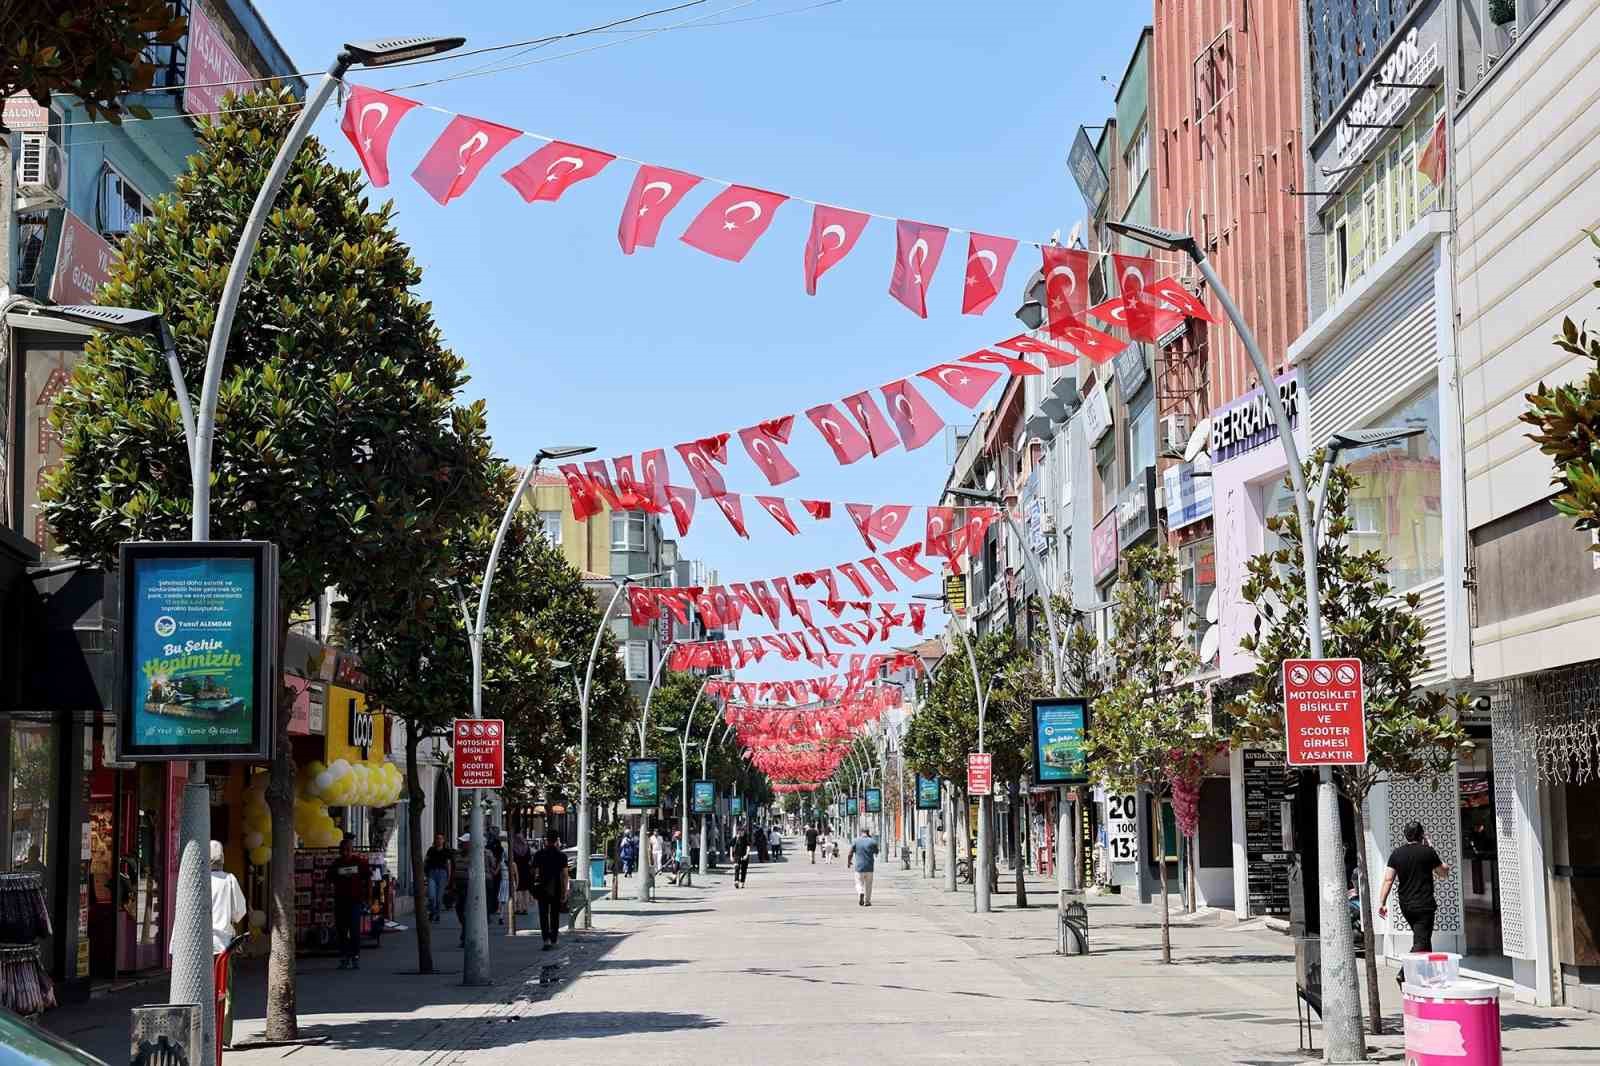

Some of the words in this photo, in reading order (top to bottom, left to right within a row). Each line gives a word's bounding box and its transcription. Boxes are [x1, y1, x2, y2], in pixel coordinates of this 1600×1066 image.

[163, 643, 183, 656] Bu
[184, 638, 223, 655] Şehir
[142, 649, 241, 677] Hepimizin
[1290, 689, 1357, 699] MOTOSİKLET
[1300, 701, 1348, 712] BİSİKLET
[1317, 714, 1332, 723] VE
[1300, 727, 1350, 736] SCOOTER
[457, 738, 500, 746] MOTOSİKLET
[1303, 737, 1348, 748] GİRMESİ
[1300, 751, 1353, 760] YASAKTIR
